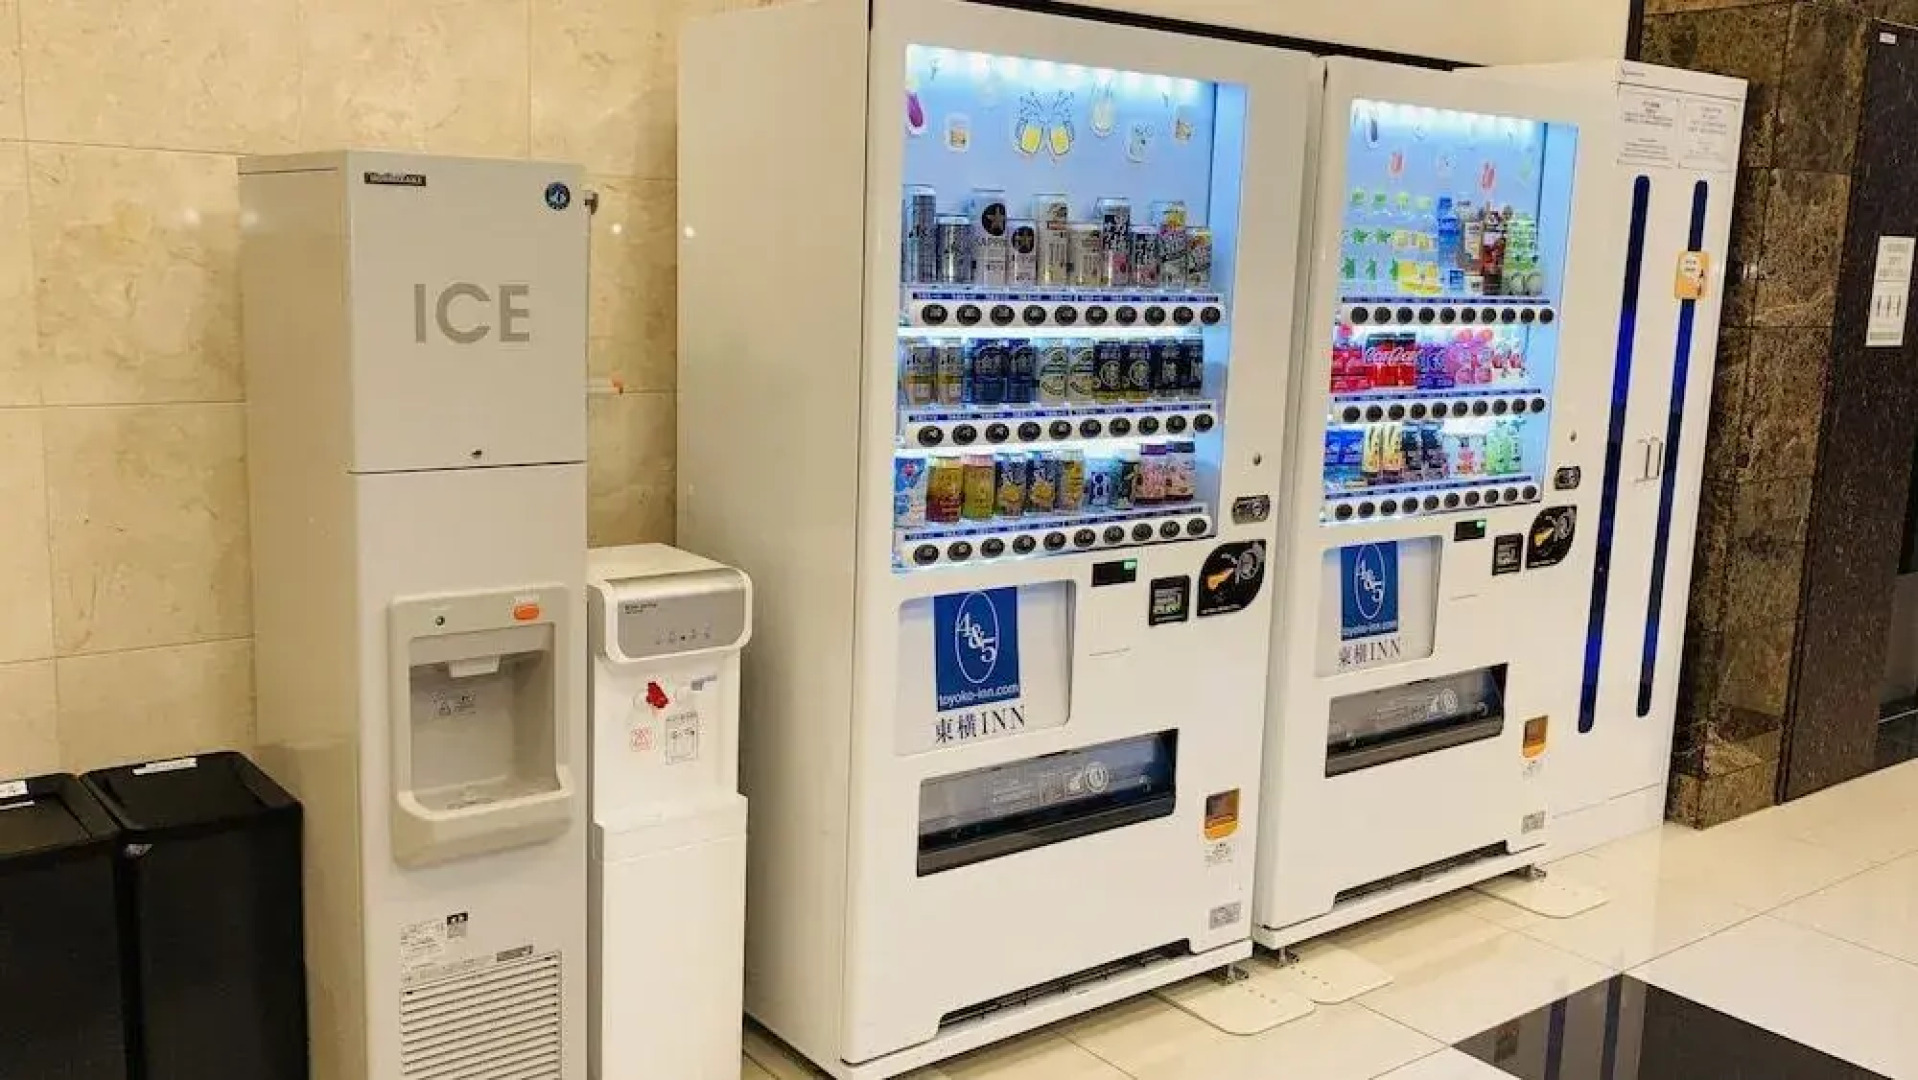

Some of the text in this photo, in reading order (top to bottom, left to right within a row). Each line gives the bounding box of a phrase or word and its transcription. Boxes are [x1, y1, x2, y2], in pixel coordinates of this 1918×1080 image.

[414, 282, 530, 344] ICE
[957, 612, 998, 663] 4&5
[939, 683, 1020, 708] toyoko-inn.com
